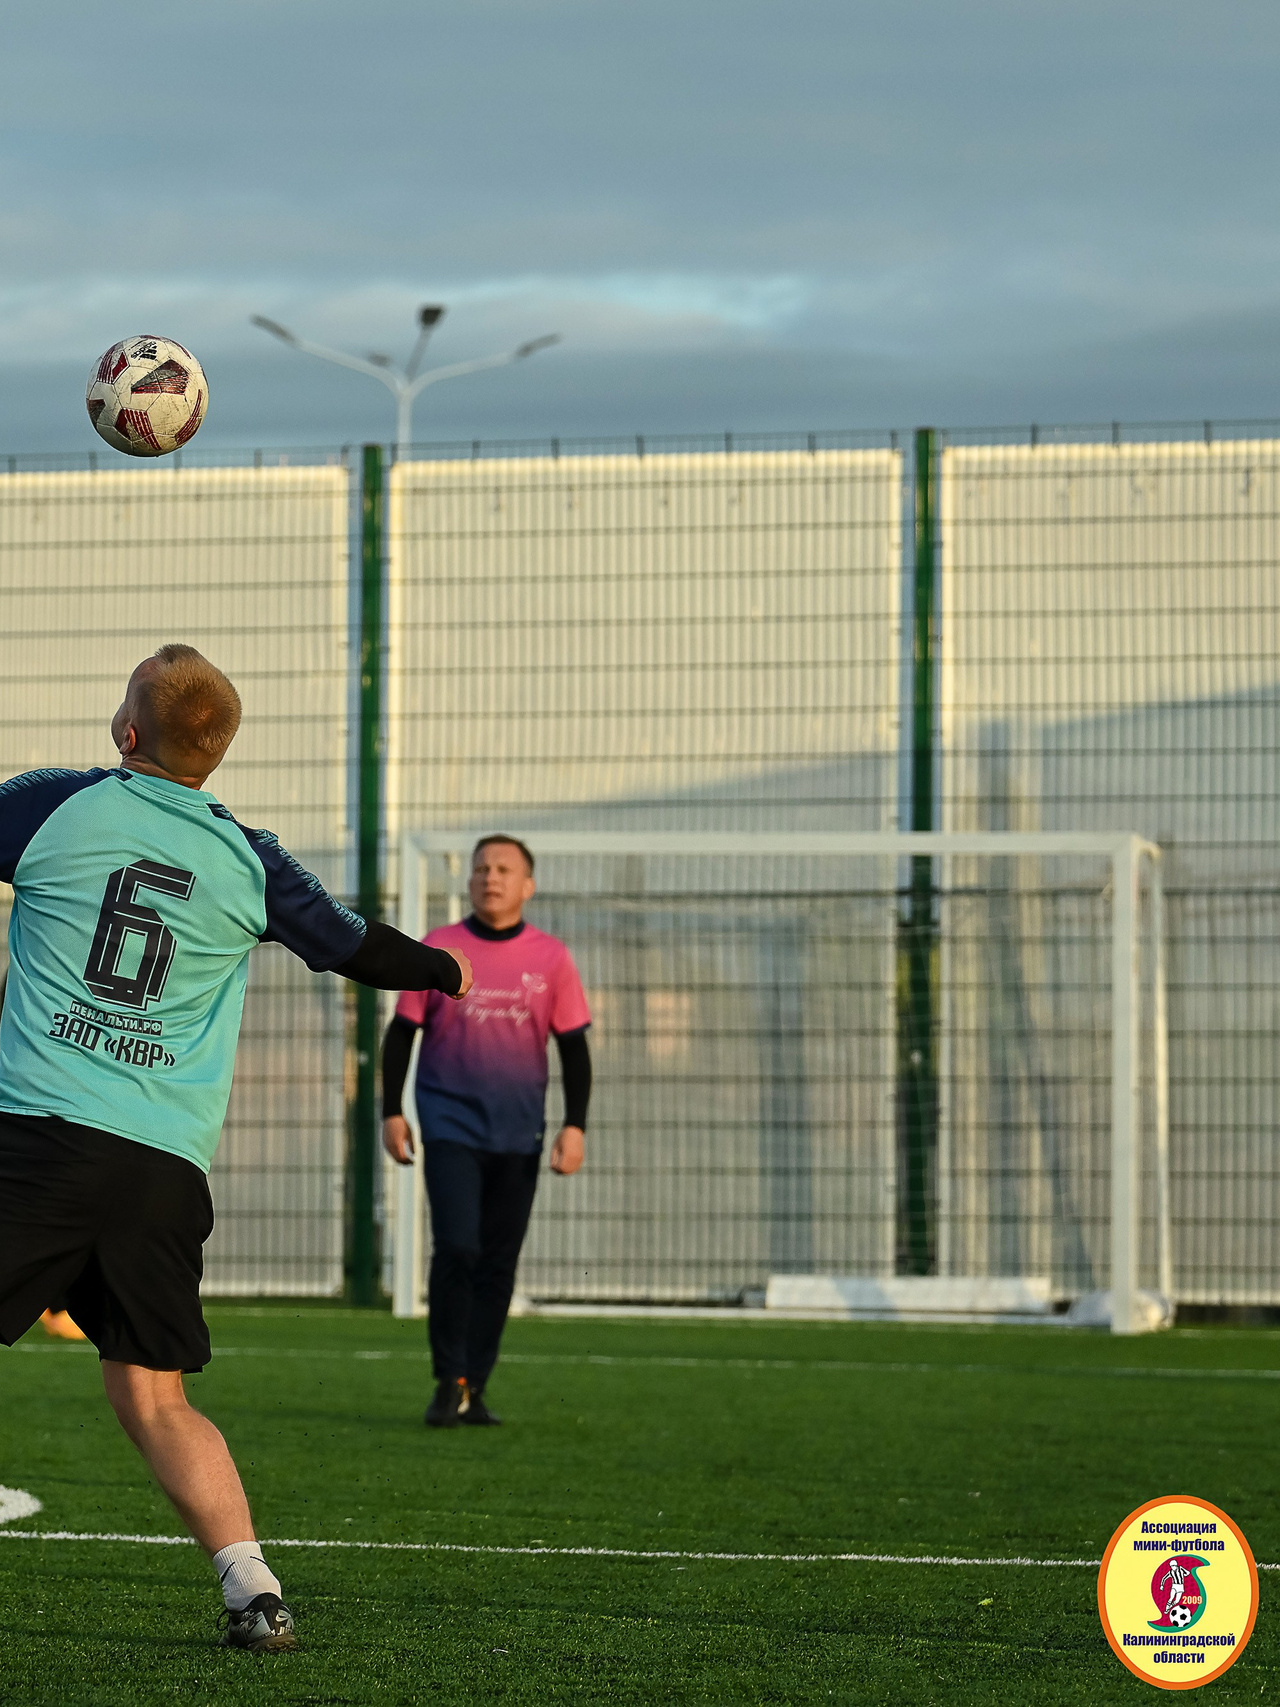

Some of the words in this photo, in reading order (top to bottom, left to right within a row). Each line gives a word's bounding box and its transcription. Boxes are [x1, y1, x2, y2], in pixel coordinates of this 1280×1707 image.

[82, 858, 197, 1011] 6
[48, 1013, 102, 1051] ЗАО
[104, 1036, 176, 1068] «КВР»
[69, 1000, 163, 1035] ПЕНАЛЬТИ.РФ
